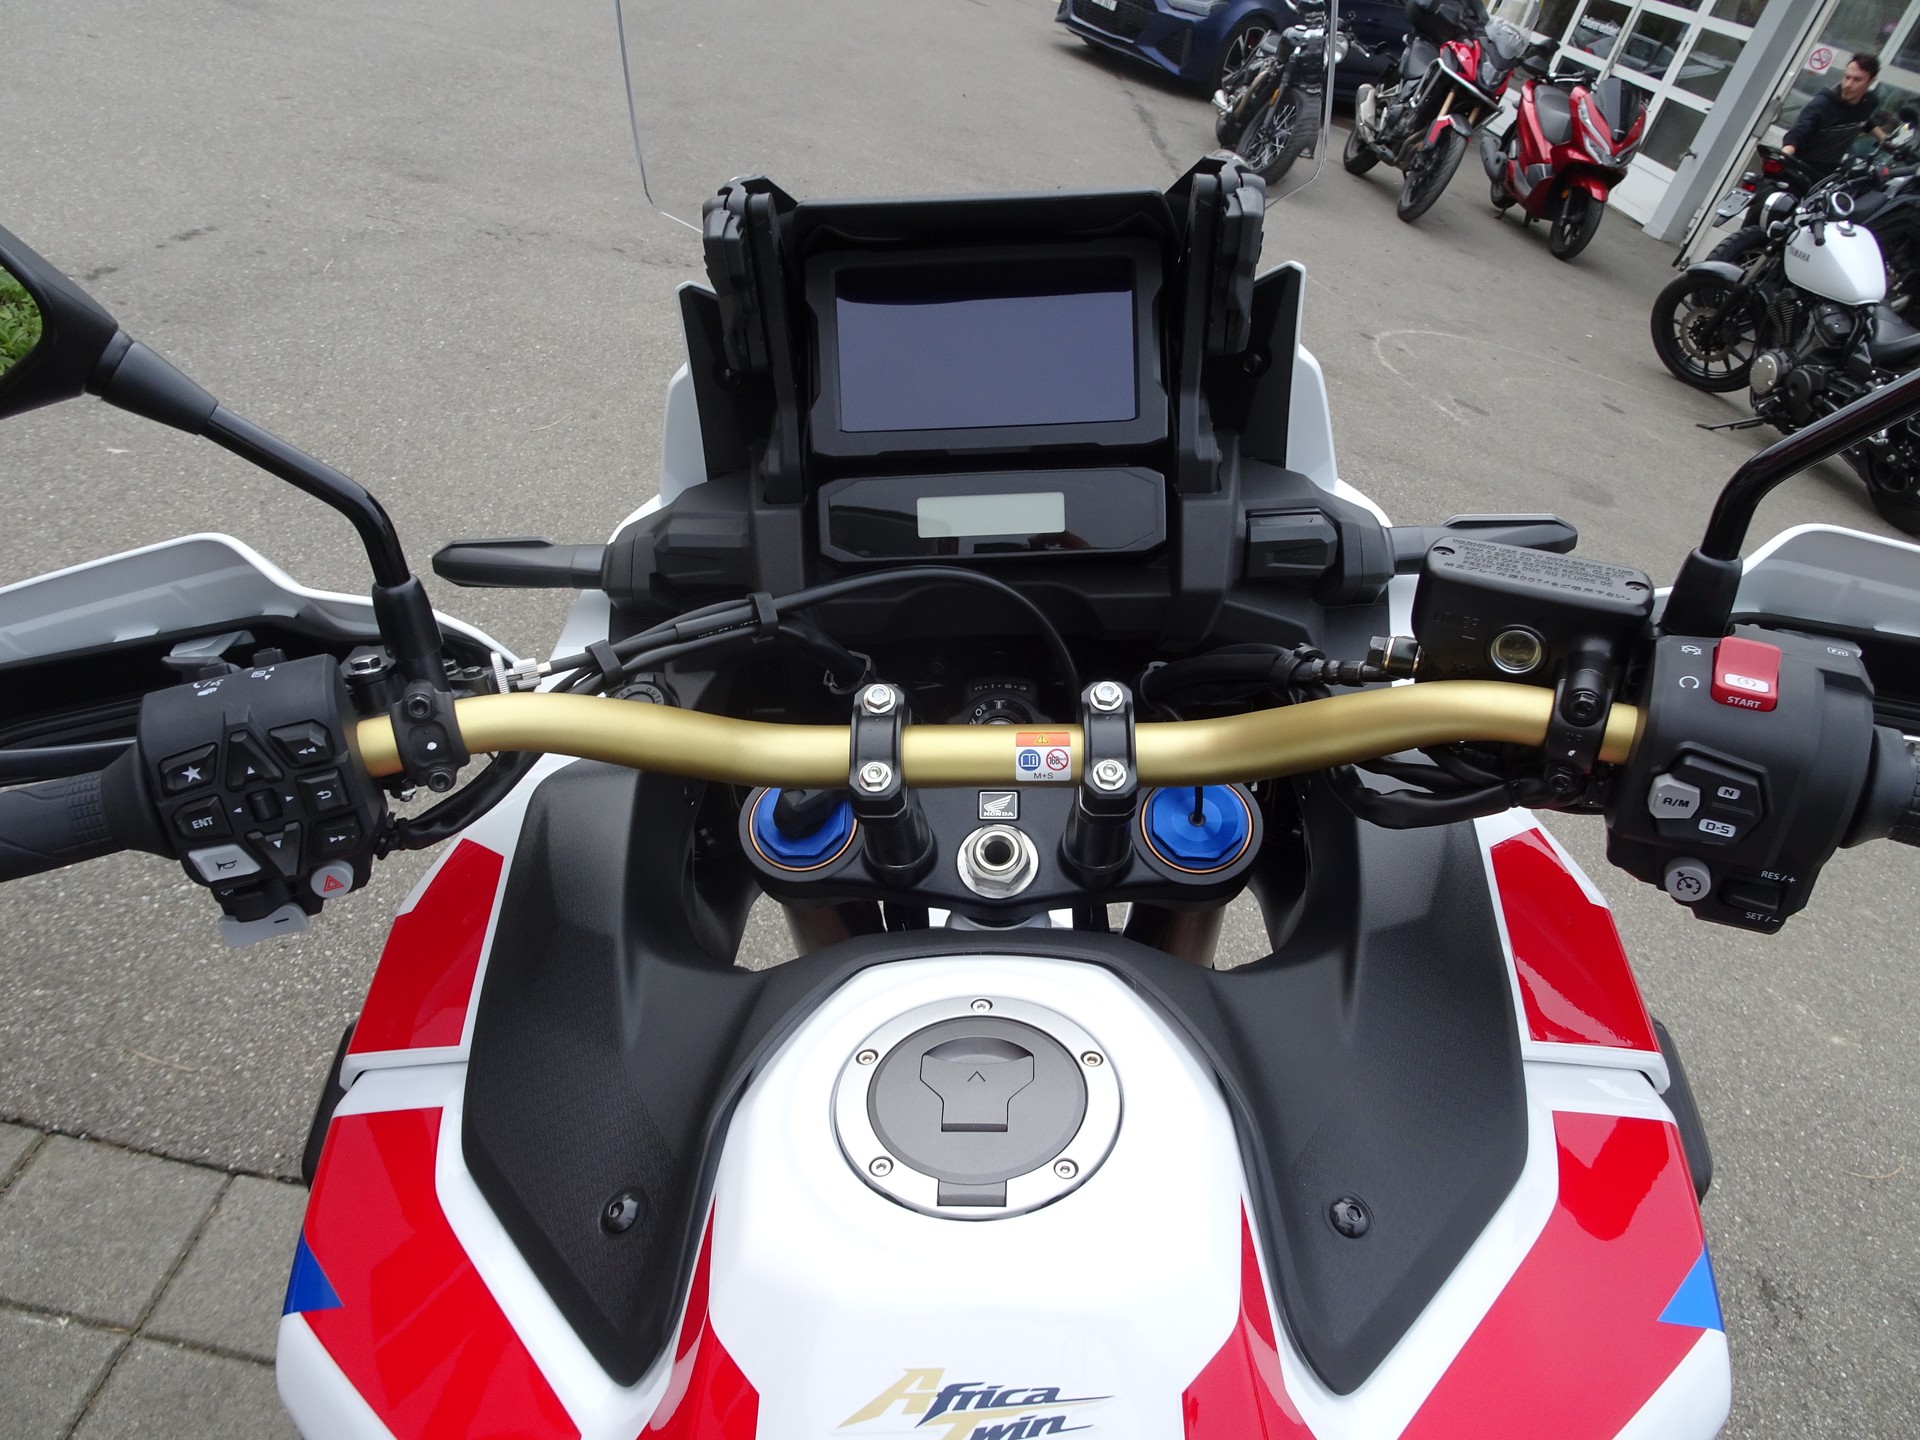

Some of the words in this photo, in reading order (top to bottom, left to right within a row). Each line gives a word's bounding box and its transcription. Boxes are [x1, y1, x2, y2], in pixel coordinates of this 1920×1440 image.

[1727, 695, 1761, 709] START
[1723, 789, 1735, 797] N
[1662, 797, 1690, 808] A/M
[191, 816, 214, 829] ENT
[1705, 821, 1730, 835] D-S
[836, 1367, 1116, 1429] Africa
[923, 1401, 1105, 1440] Twin
